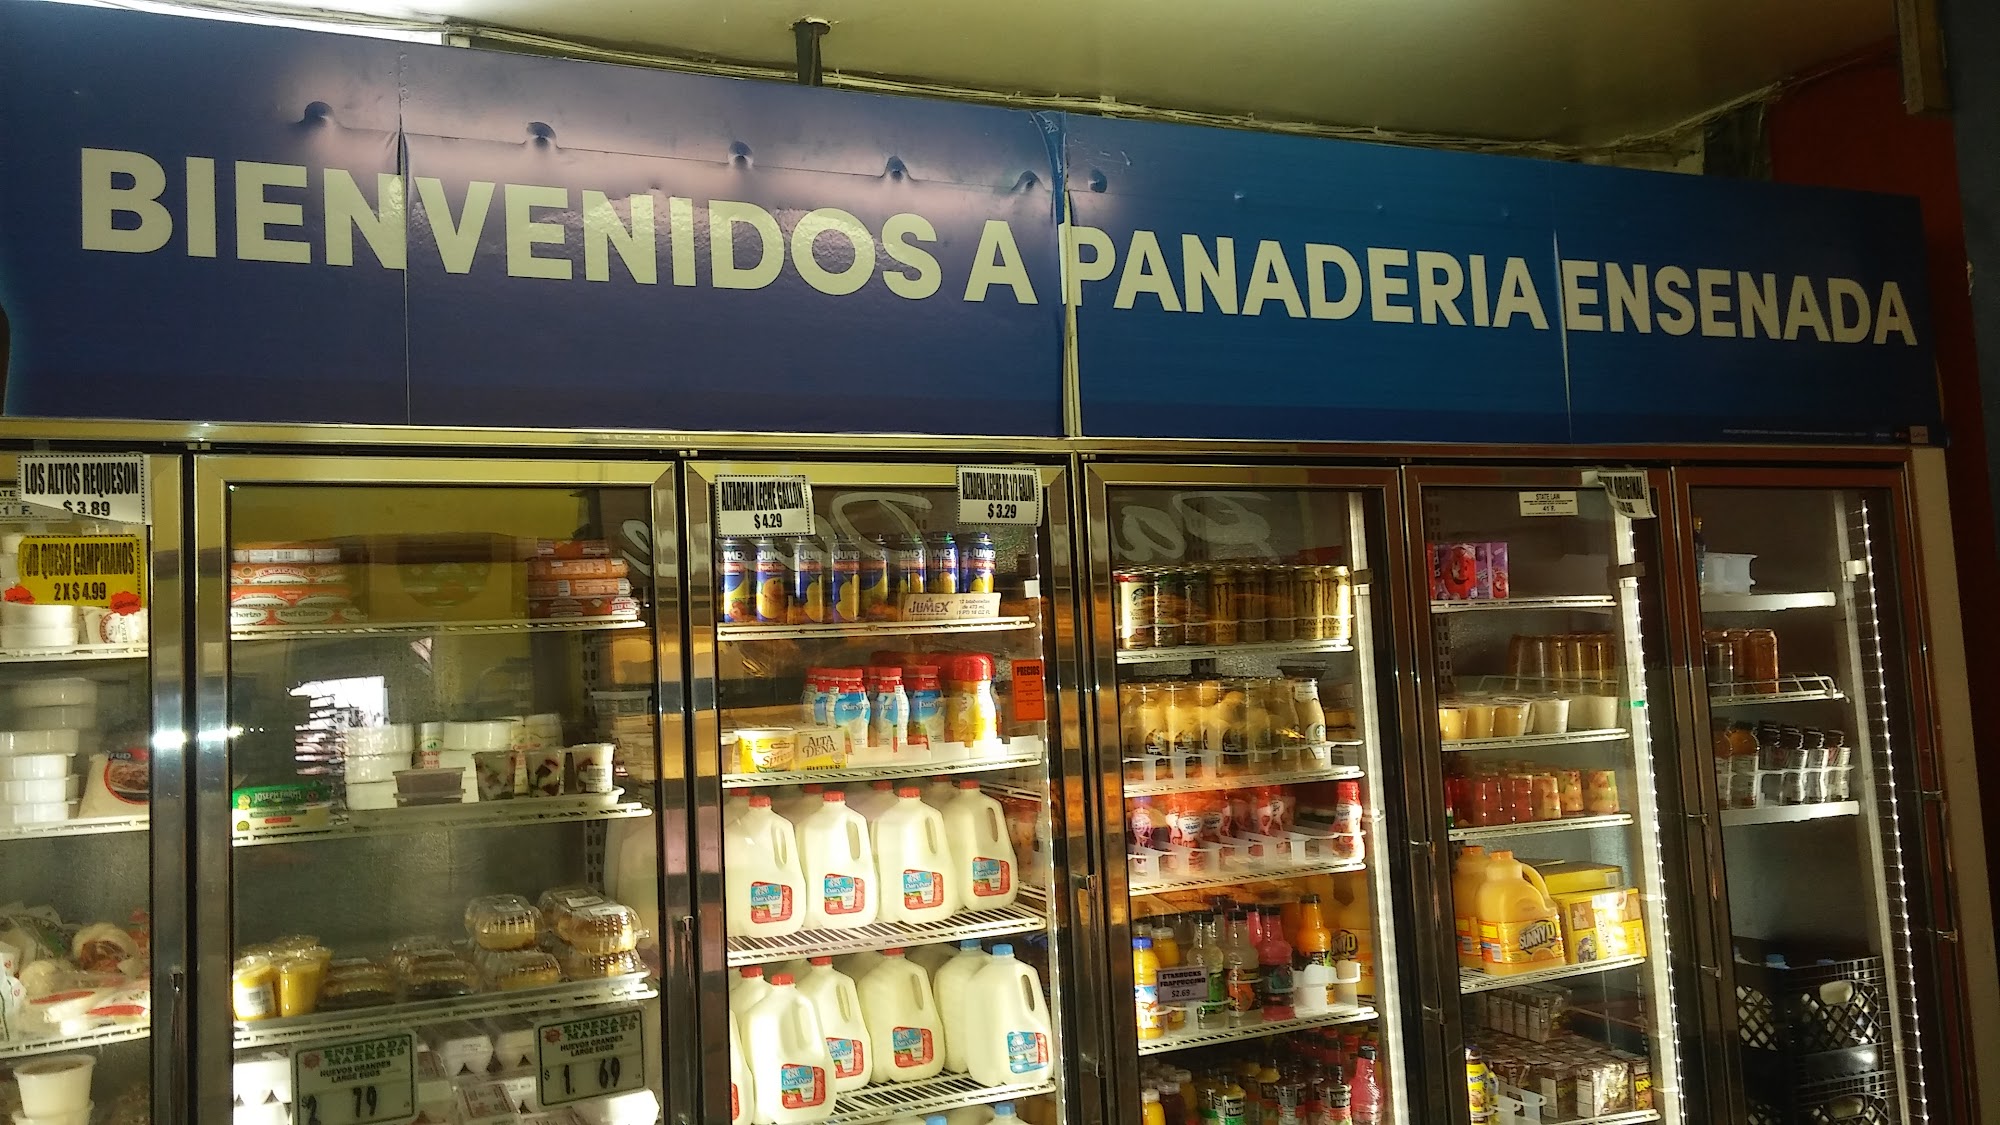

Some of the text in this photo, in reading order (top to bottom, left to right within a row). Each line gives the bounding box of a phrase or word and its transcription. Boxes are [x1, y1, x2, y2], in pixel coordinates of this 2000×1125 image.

[81, 147, 1918, 348] BIENVENIDOS A PANADERIA ENSENADA
[25, 462, 139, 498] LOS ALTOS REQUESON
[721, 481, 804, 511] ALTADENA LECHE GALLON
[41, 543, 72, 580] QUESO
[73, 542, 135, 576] CAMPIRANOS
[908, 600, 950, 614] JUMEX
[1017, 665, 1040, 677] PRECIOS
[808, 735, 834, 747] ALTA
[803, 744, 837, 758] DENA
[254, 790, 280, 803] JOSEPH
[1518, 923, 1547, 950] SUNNY
[1160, 977, 1207, 987] FRAPPUCCINO
[1162, 970, 1202, 980] STARBUCKS
[563, 1014, 639, 1034] ENSENADA
[567, 1022, 636, 1041] MARKETS
[324, 1039, 409, 1059] ENSENADA
[560, 1035, 624, 1052] HUEVOS GRANDES
[570, 1044, 615, 1057] LARGE EGGS
[327, 1046, 405, 1066] MARKETS
[320, 1060, 391, 1078] HUEVOS GRANDES
[331, 1070, 381, 1083] LARGE EGGS
